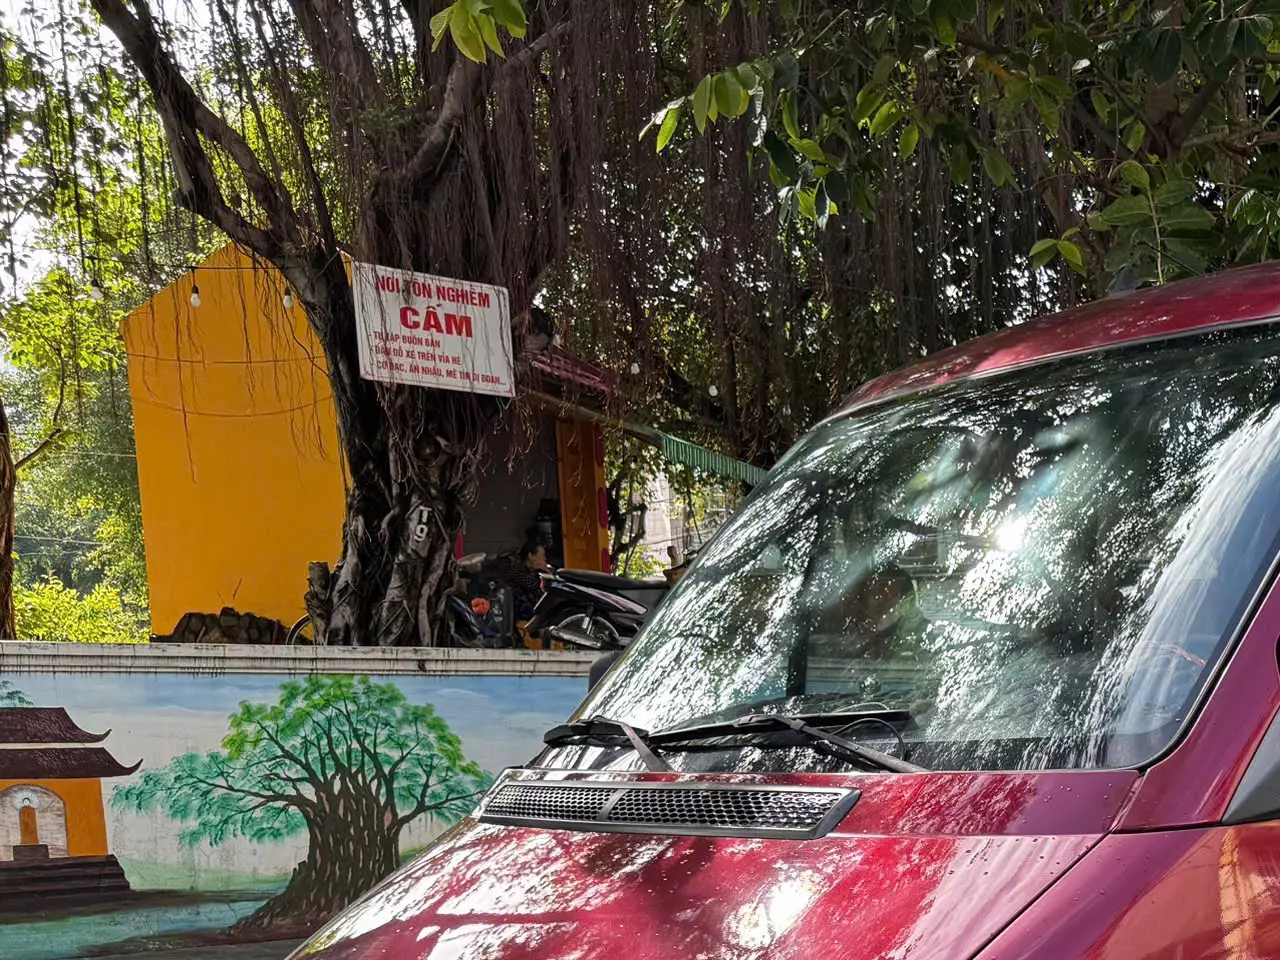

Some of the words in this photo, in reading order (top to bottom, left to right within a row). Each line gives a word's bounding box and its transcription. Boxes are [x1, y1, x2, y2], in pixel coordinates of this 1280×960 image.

[403, 278, 432, 299] ÔN
[436, 283, 490, 309] NGHIÊM
[400, 304, 473, 338] CẤM
[414, 524, 428, 541] 9
